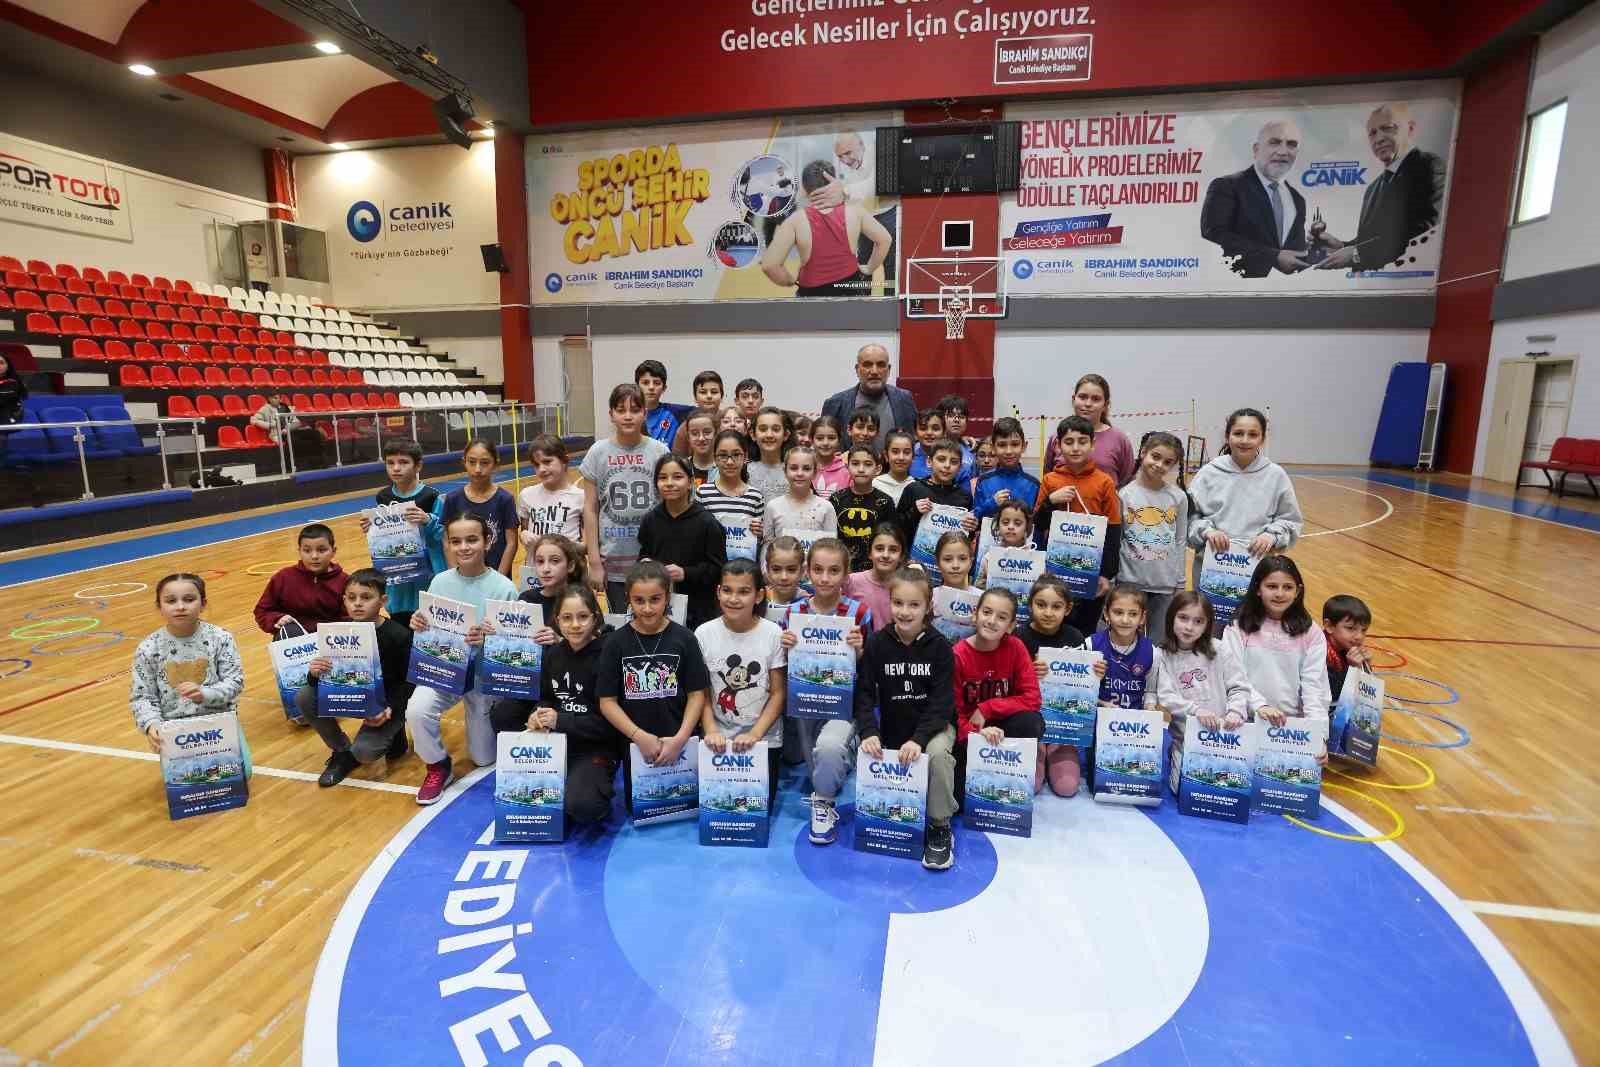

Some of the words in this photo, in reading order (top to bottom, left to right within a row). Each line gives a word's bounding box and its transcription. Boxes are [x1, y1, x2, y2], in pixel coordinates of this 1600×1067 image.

[720, 26, 807, 52] Gelecek
[813, 16, 900, 45] Nesiller
[906, 8, 947, 42] İçin
[953, 6, 1096, 40] Çalışıyoruz.
[998, 46, 1040, 63] İBRAHİM
[1040, 45, 1088, 63] SANDIKÇI
[1019, 111, 1176, 153] GENÇLERİMİZE
[577, 142, 682, 192] SPORDA
[1019, 152, 1085, 180] YÖNELİK
[1086, 148, 1204, 177] PROJELERİMİZ
[1301, 166, 1368, 187] CANİK
[1016, 183, 1076, 207] ÖDÜLLE
[1079, 181, 1199, 209] TAÇLANDIRILDI
[389, 202, 453, 220] canik
[390, 220, 454, 232] belediyesi
[563, 202, 694, 264] CANİK
[1021, 220, 1063, 234] Gençliğe
[1066, 217, 1100, 230] Yatırım
[1008, 235, 1065, 250] Geleceğe
[1071, 231, 1113, 246] Yatırım
[1037, 257, 1074, 268] canik
[1084, 257, 1137, 269] İBRAHİM
[1138, 256, 1200, 270] SANDIKÇI
[565, 271, 598, 282] canik
[604, 269, 650, 281] İBRAHİM
[650, 268, 703, 280] SANDIKÇI
[1095, 270, 1118, 279] Canik
[1119, 269, 1154, 279] Belediye
[607, 454, 644, 466] LOVE
[609, 480, 651, 511] 68
[1059, 522, 1096, 536] CANİK
[998, 558, 1033, 571] CANİK
[1214, 552, 1251, 566] CANİK
[429, 605, 465, 623] CANİK
[326, 635, 361, 646] CANİK
[802, 627, 843, 641] CANİK
[283, 642, 320, 657] CANİK
[884, 662, 905, 676] NEW
[1050, 660, 1090, 675] CANİK
[1109, 720, 1150, 735] CANİK
[1267, 727, 1312, 743] CANİK
[174, 728, 224, 746] CANİK
[1198, 730, 1241, 747] CANİK
[510, 746, 553, 759] CANİK
[979, 747, 1022, 763] CANİK
[711, 755, 755, 768] CANİK
[437, 818, 587, 1067] EDİYE
